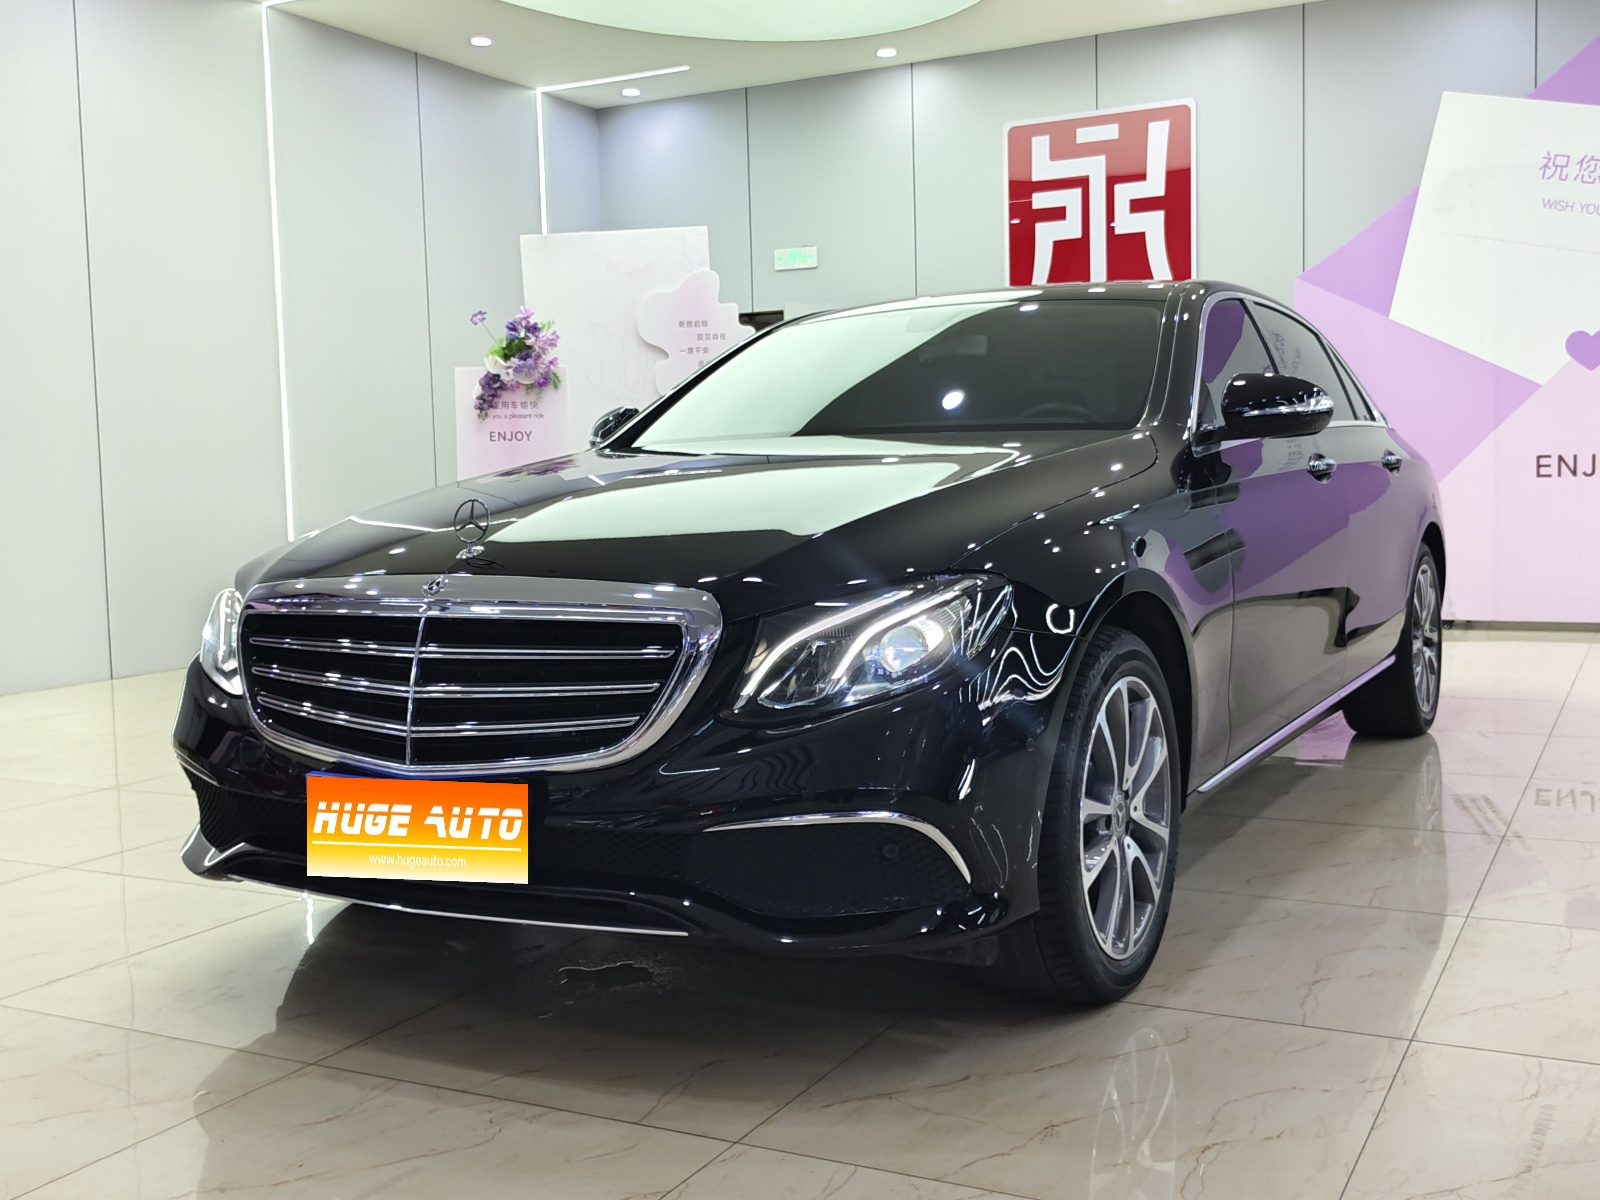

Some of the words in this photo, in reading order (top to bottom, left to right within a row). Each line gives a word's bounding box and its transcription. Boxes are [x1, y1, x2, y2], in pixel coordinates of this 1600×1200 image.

[1539, 151, 1600, 184] 祝您
[1542, 198, 1575, 212] WISH
[489, 430, 533, 442] ENJOY
[1536, 453, 1596, 478] ENJ
